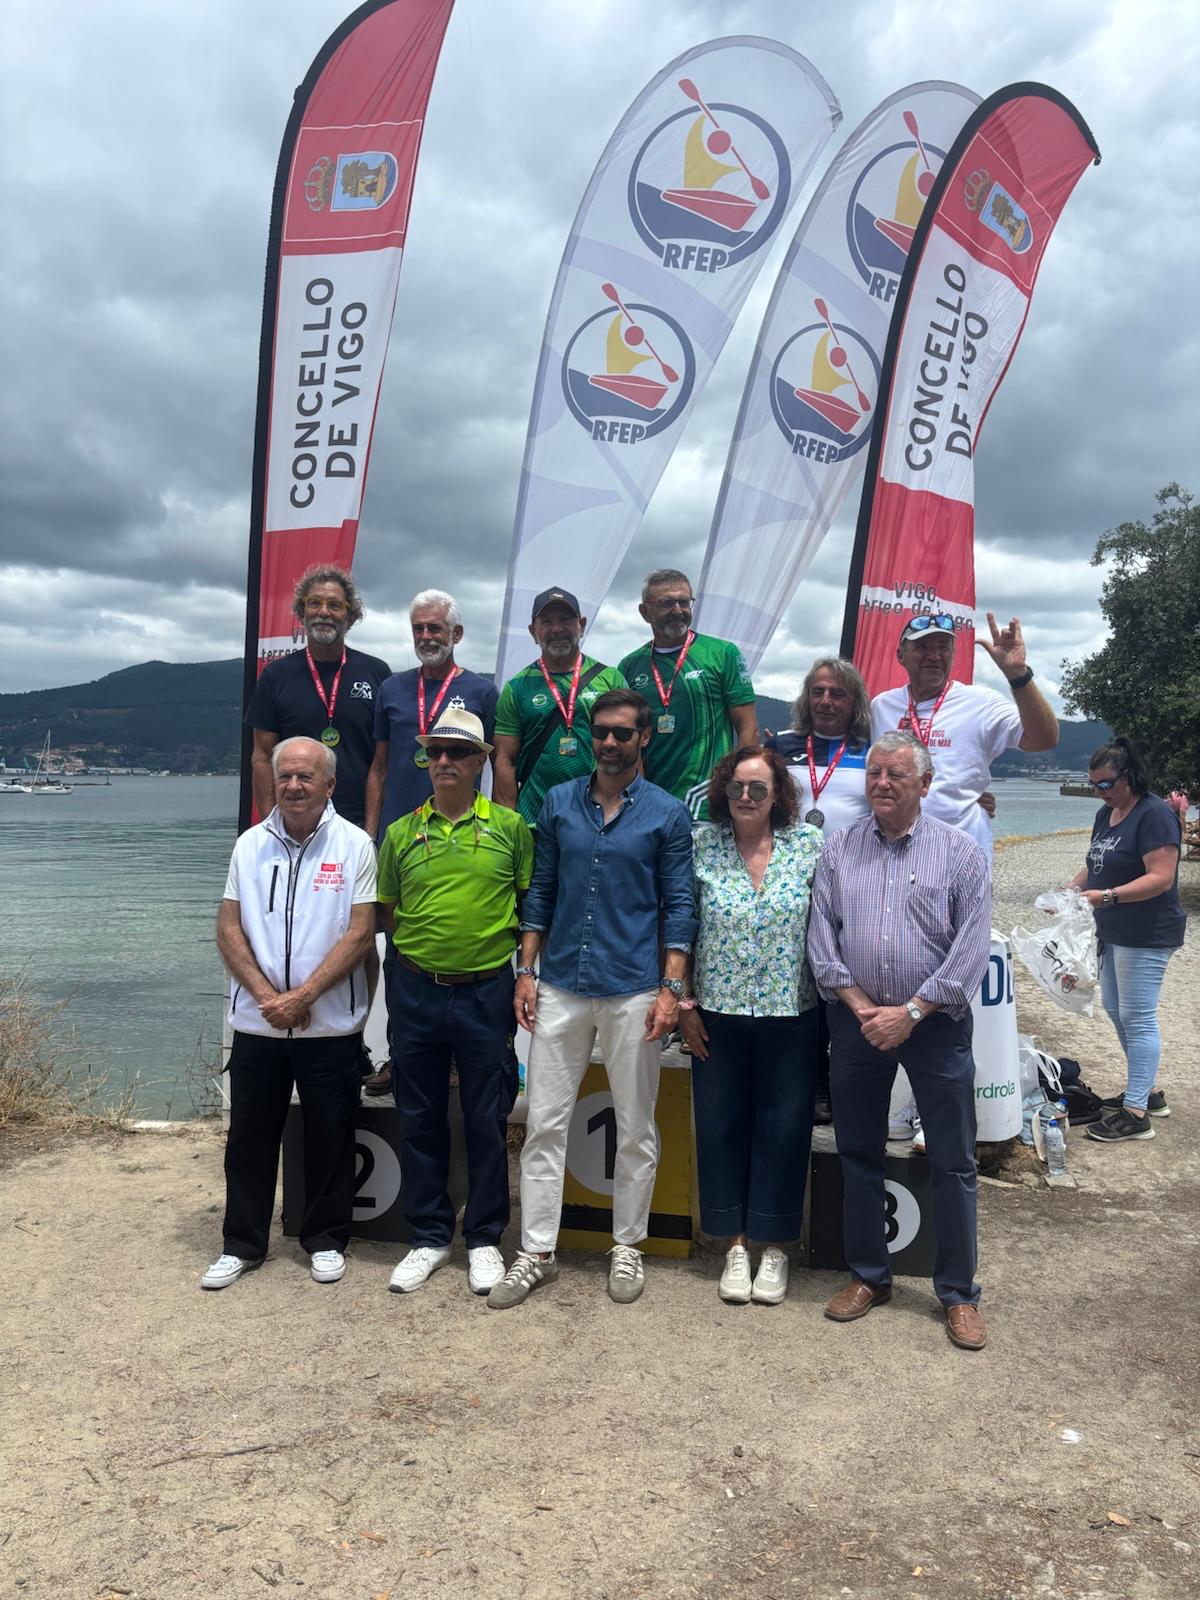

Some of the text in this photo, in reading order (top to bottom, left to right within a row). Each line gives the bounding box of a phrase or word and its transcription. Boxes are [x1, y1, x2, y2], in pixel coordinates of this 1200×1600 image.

[662, 242, 729, 274] RFEP
[868, 271, 899, 303] RF
[904, 262, 967, 472] CONCELLO
[290, 278, 334, 509] CONCELLO
[325, 302, 367, 478] DE VIGO
[592, 419, 645, 446] RFEP
[792, 433, 839, 464] RFEP
[292, 626, 305, 644] VI
[976, 1080, 1016, 1099] rdrola
[587, 1107, 617, 1179] 1
